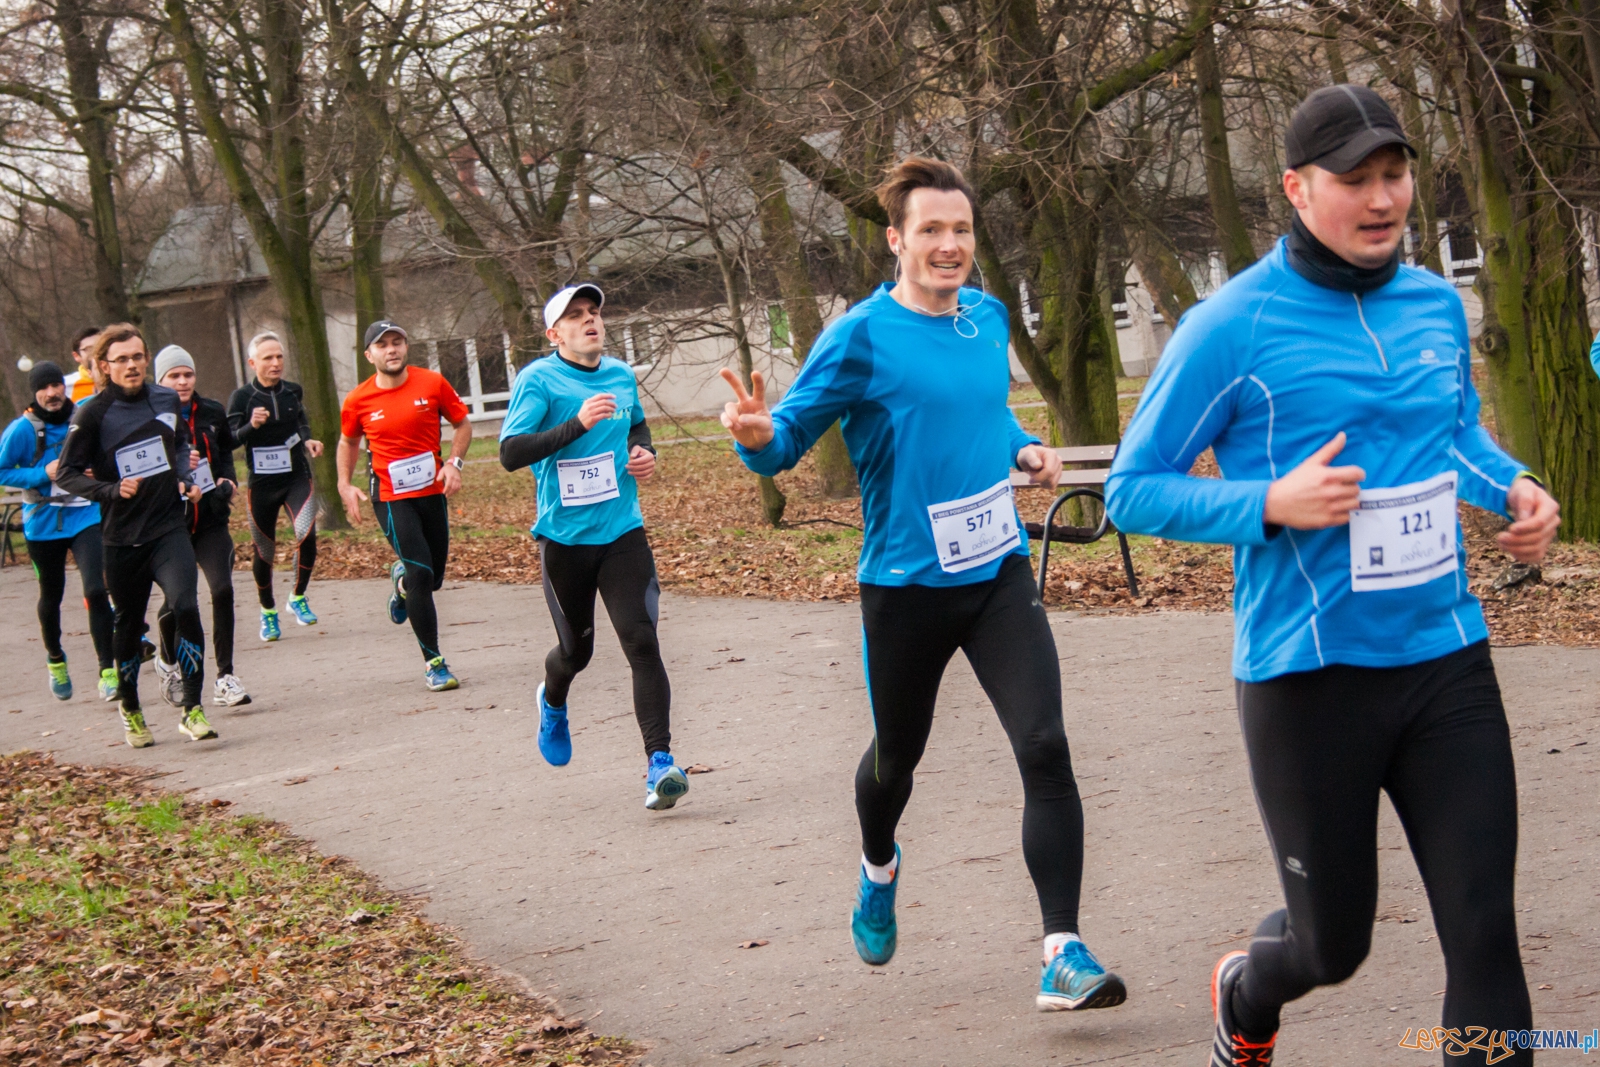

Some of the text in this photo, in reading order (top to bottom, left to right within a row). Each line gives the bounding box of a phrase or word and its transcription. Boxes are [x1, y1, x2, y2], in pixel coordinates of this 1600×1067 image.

[136, 450, 147, 459] 62
[406, 465, 421, 475] 125
[580, 467, 600, 480] 752
[966, 510, 992, 532] 577
[1400, 510, 1433, 535] 121
